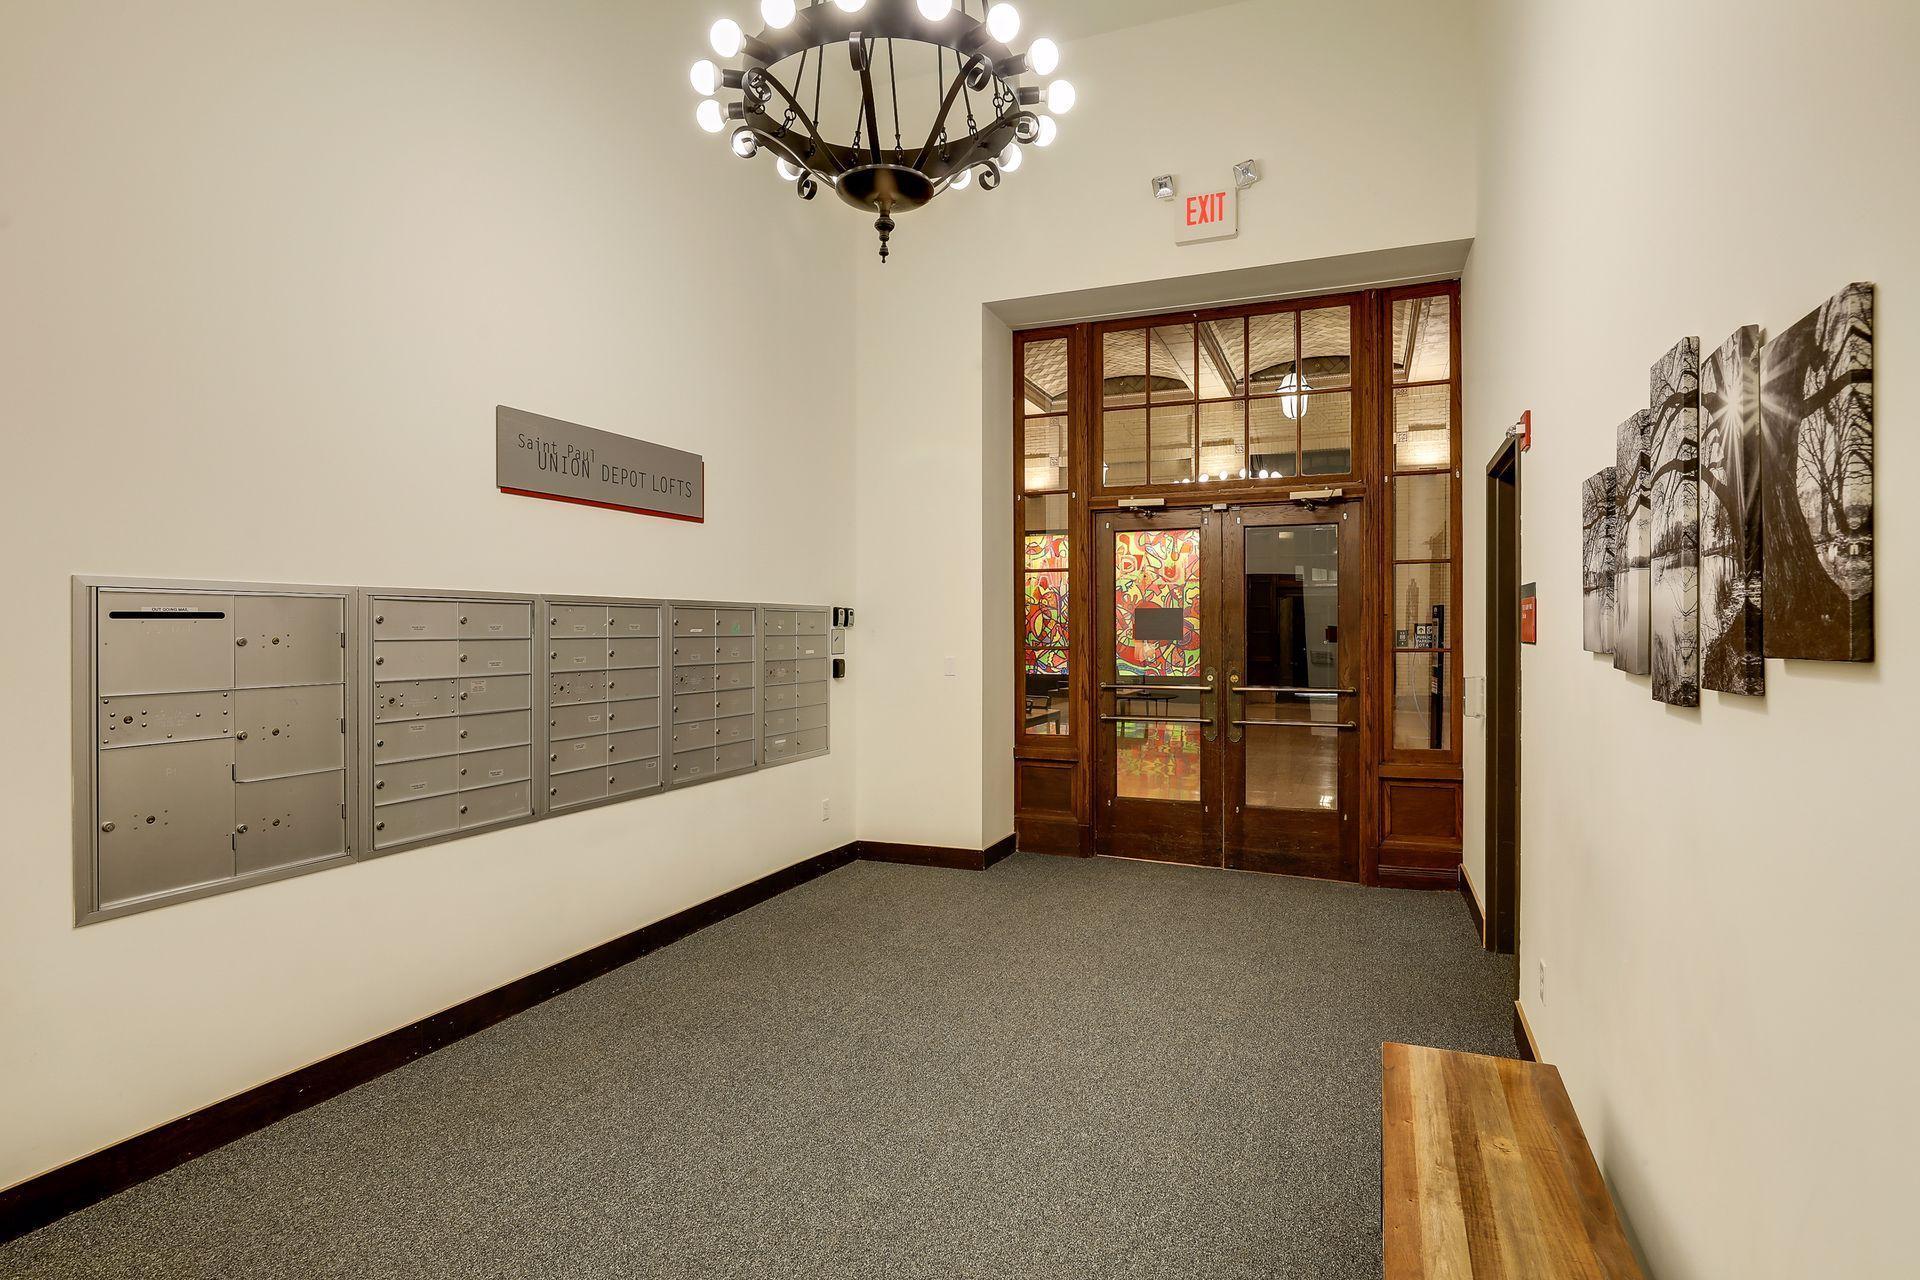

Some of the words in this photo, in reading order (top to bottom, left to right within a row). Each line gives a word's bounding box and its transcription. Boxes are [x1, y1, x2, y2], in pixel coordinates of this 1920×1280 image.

[1186, 192, 1226, 226] EXIT
[518, 433, 558, 455] Saint
[567, 444, 595, 463] Paul
[538, 451, 590, 479] UNION
[602, 464, 647, 489] DEPOT
[652, 474, 692, 498] LOFTS
